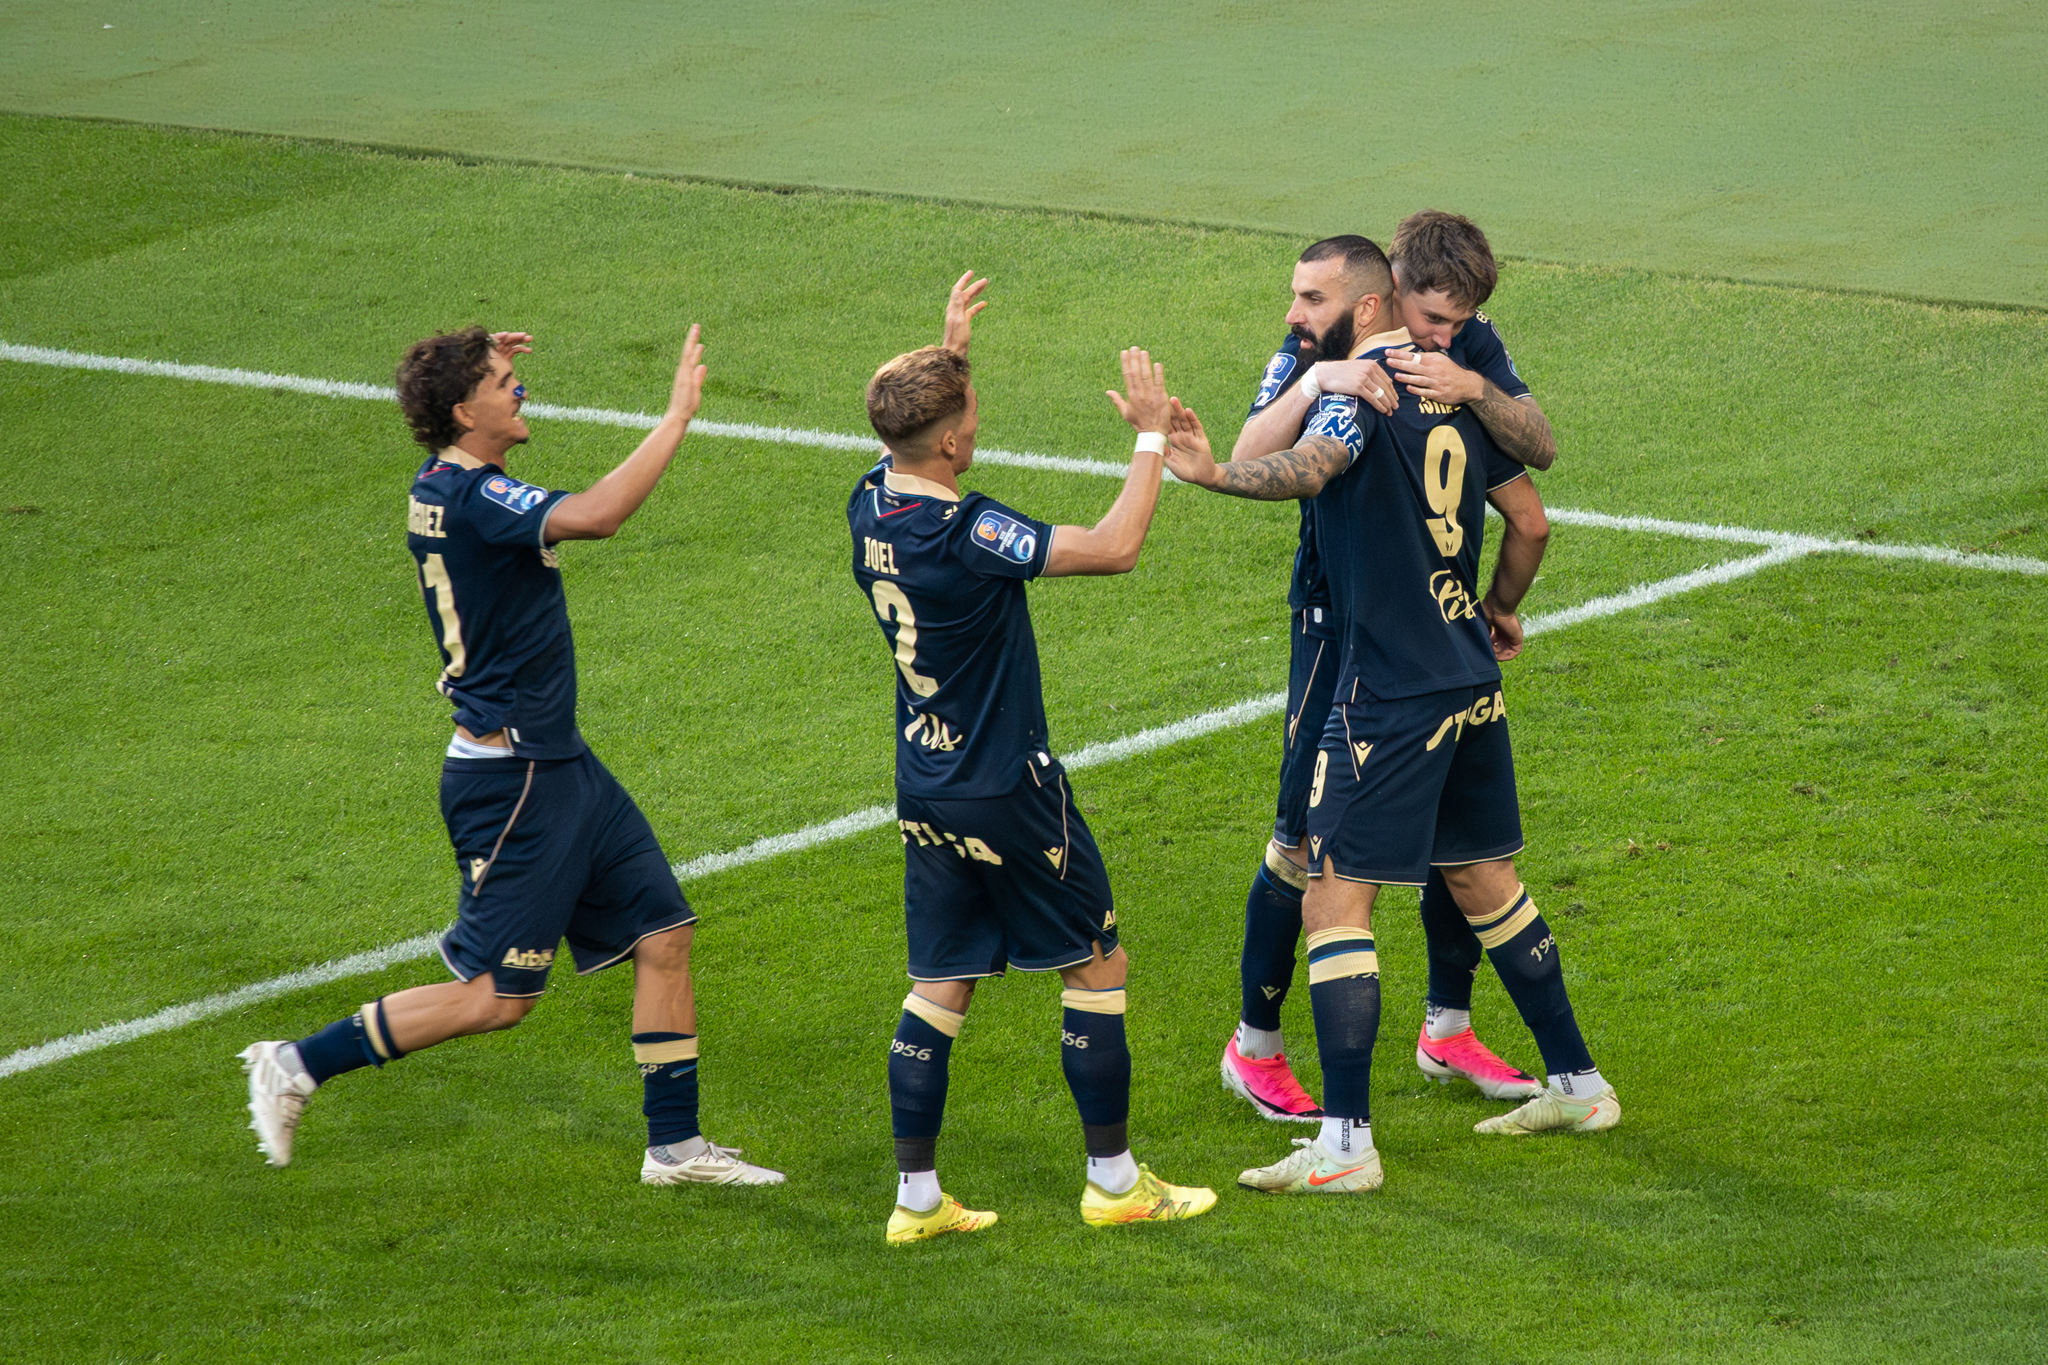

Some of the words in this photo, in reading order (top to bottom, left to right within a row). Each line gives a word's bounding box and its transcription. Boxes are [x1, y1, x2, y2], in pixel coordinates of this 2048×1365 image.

[1424, 425, 1468, 557] 9
[863, 536, 899, 576] JOEL
[871, 580, 940, 699] 2
[1309, 750, 1329, 808] 9
[890, 1038, 933, 1061] 1956
